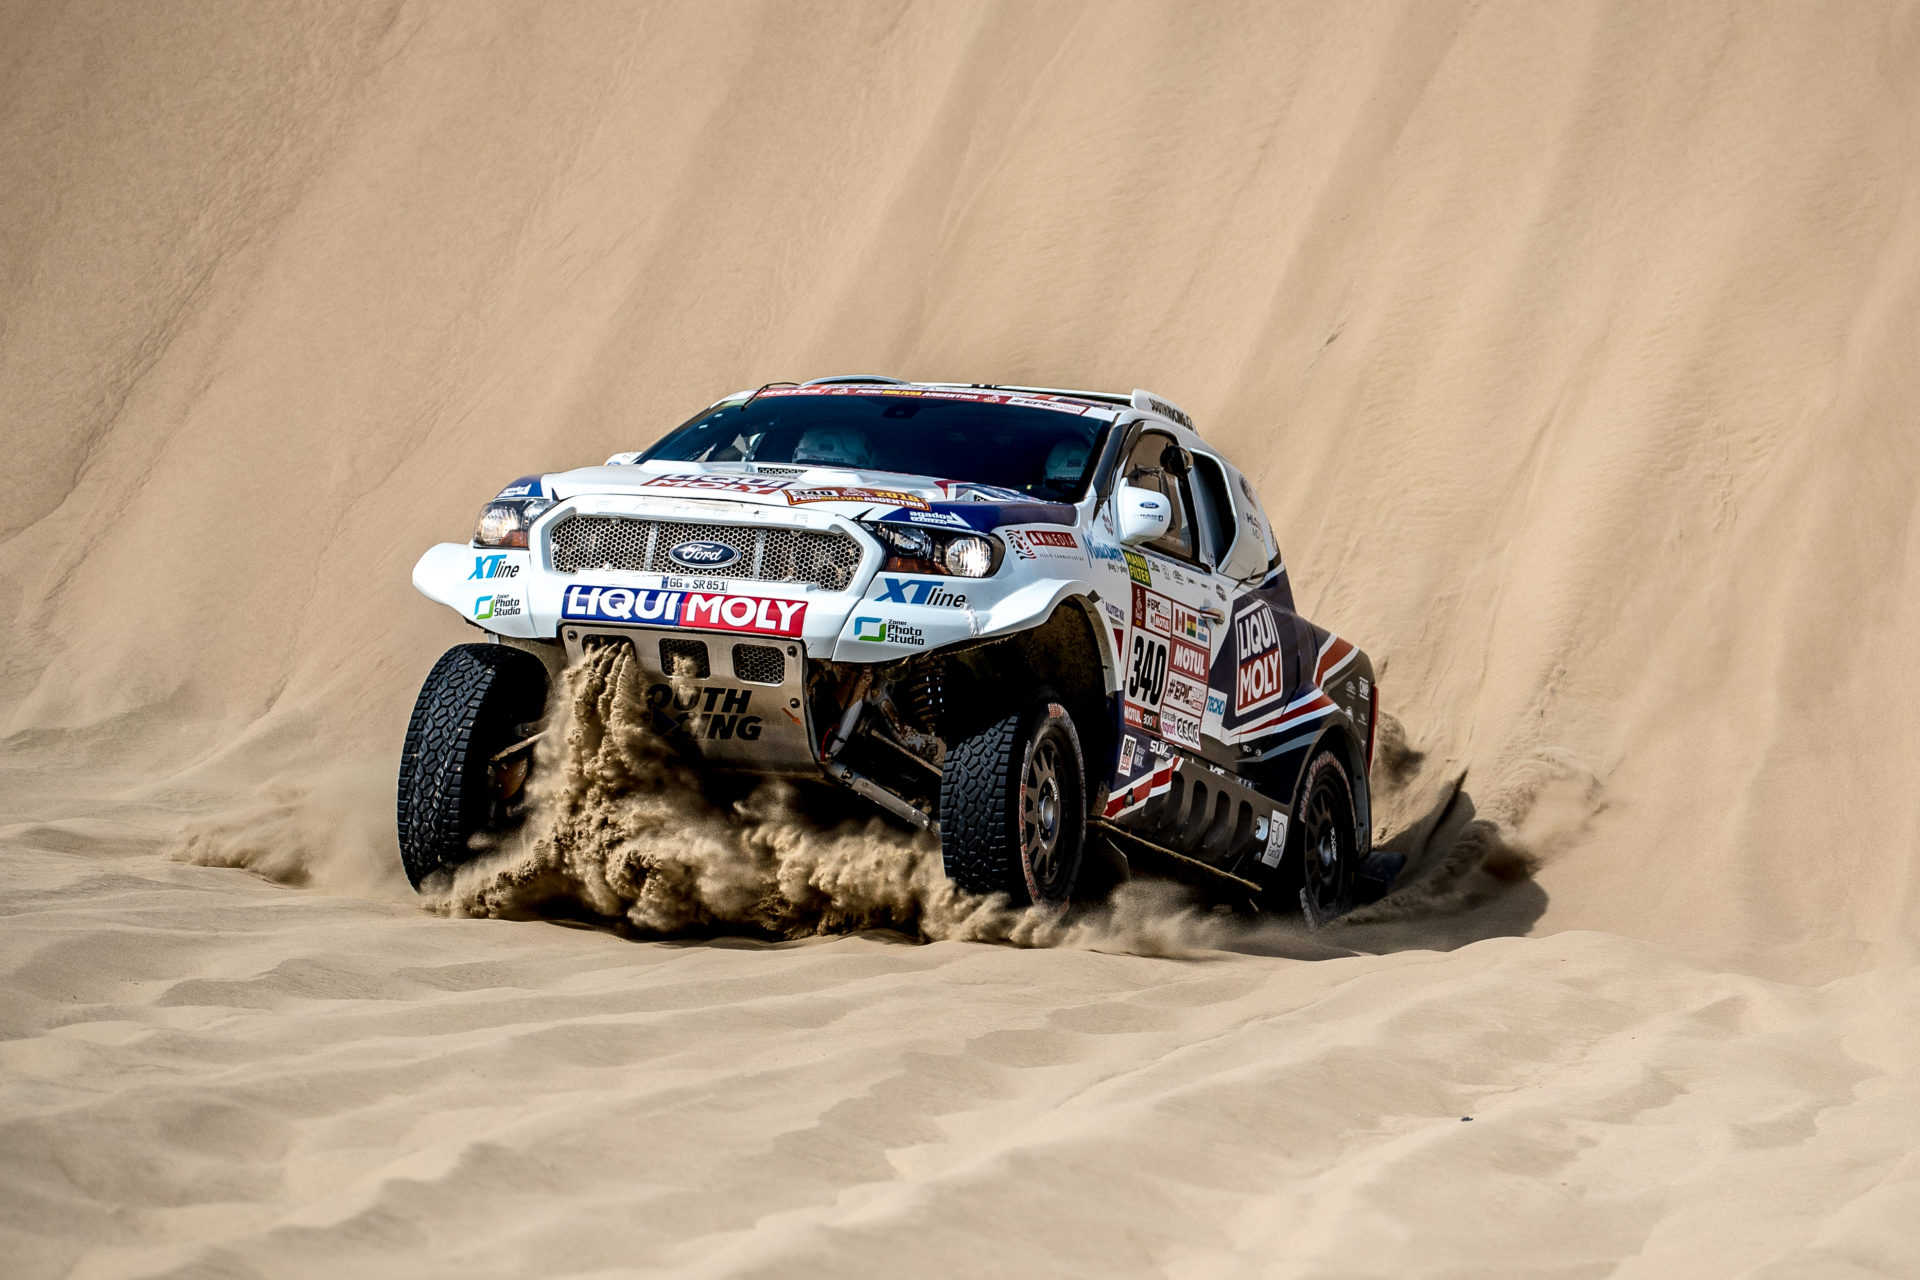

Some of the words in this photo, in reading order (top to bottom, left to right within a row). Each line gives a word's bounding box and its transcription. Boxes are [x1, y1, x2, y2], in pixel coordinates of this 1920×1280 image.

[921, 392, 980, 401] ARGENTINA
[650, 479, 775, 494] MOLY
[660, 473, 791, 489] LIQUI
[793, 494, 821, 502] PERU
[863, 496, 926, 509] ARGENTINA
[875, 490, 921, 502] 2018
[682, 543, 724, 561] Ford
[1123, 551, 1147, 570] MANN
[467, 554, 520, 581] XTline
[1129, 565, 1152, 584] FILTER
[669, 578, 683, 588] GG
[874, 578, 967, 608] XTline
[494, 606, 521, 617] Studio
[495, 598, 520, 607] Photo
[567, 587, 681, 620] LIQUI
[686, 593, 806, 632] MOLY
[887, 625, 922, 636] Photo
[1155, 615, 1170, 631] MOTUL
[887, 633, 925, 646] Studio
[1239, 607, 1277, 660] LIQUI
[1174, 644, 1206, 677] MOTUL
[1128, 635, 1167, 706] 340
[1239, 651, 1279, 706] MOLY
[645, 683, 753, 714] OUTH
[1124, 704, 1142, 724] MOTUL
[1161, 721, 1176, 736] sport
[1270, 818, 1285, 848] 50
